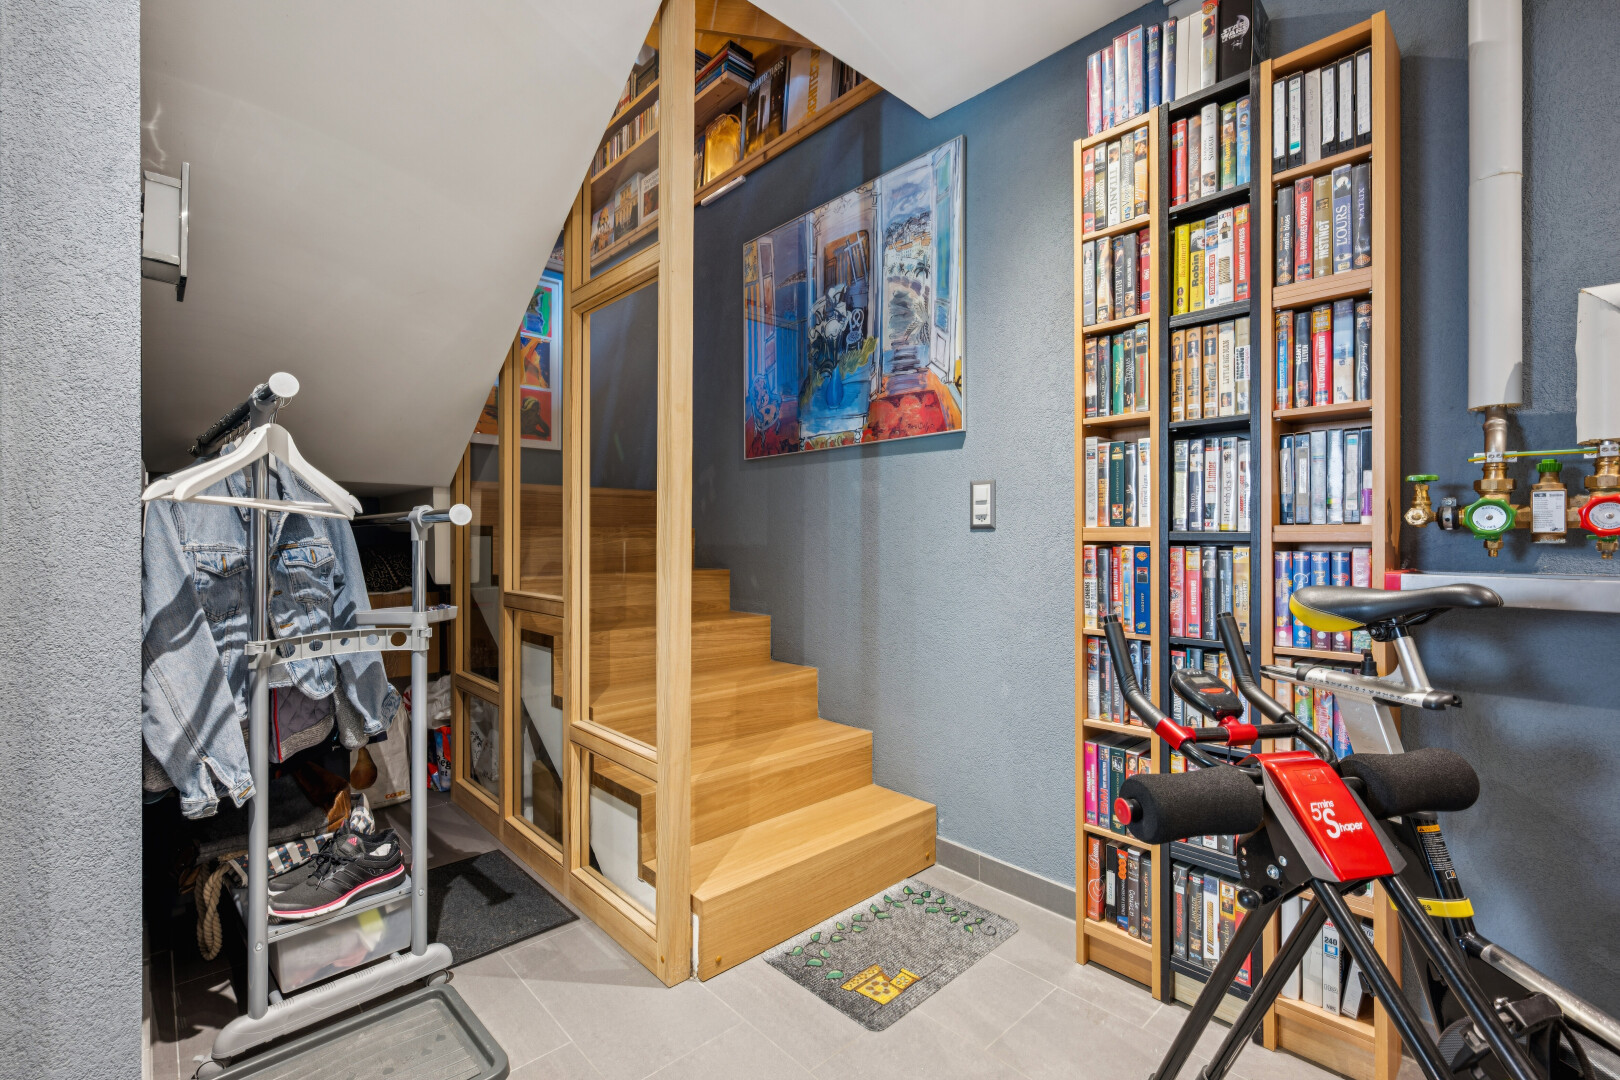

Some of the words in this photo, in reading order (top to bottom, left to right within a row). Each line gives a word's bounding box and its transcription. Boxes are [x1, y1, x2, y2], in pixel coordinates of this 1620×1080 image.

[1109, 167, 1118, 215] TITANIC
[1283, 214, 1291, 231] blues
[1299, 195, 1308, 225] POURPRES
[1335, 204, 1348, 246] L'OURS
[1238, 226, 1246, 252] EXPRESS
[1283, 232, 1291, 250] mafia
[1318, 219, 1330, 260] INSTINCT
[1084, 263, 1094, 296] FESTEN
[1190, 253, 1200, 288] Robin
[1238, 253, 1246, 281] MIDNIGHT
[1171, 373, 1182, 397] Parrain
[1187, 367, 1198, 391] Parrain
[1204, 367, 1216, 392] Parrain
[1222, 364, 1231, 385] LITTLE
[1206, 461, 1217, 483] Limier
[1206, 484, 1217, 493] Le
[1323, 808, 1363, 839] Shaper
[1324, 936, 1338, 946] 240
